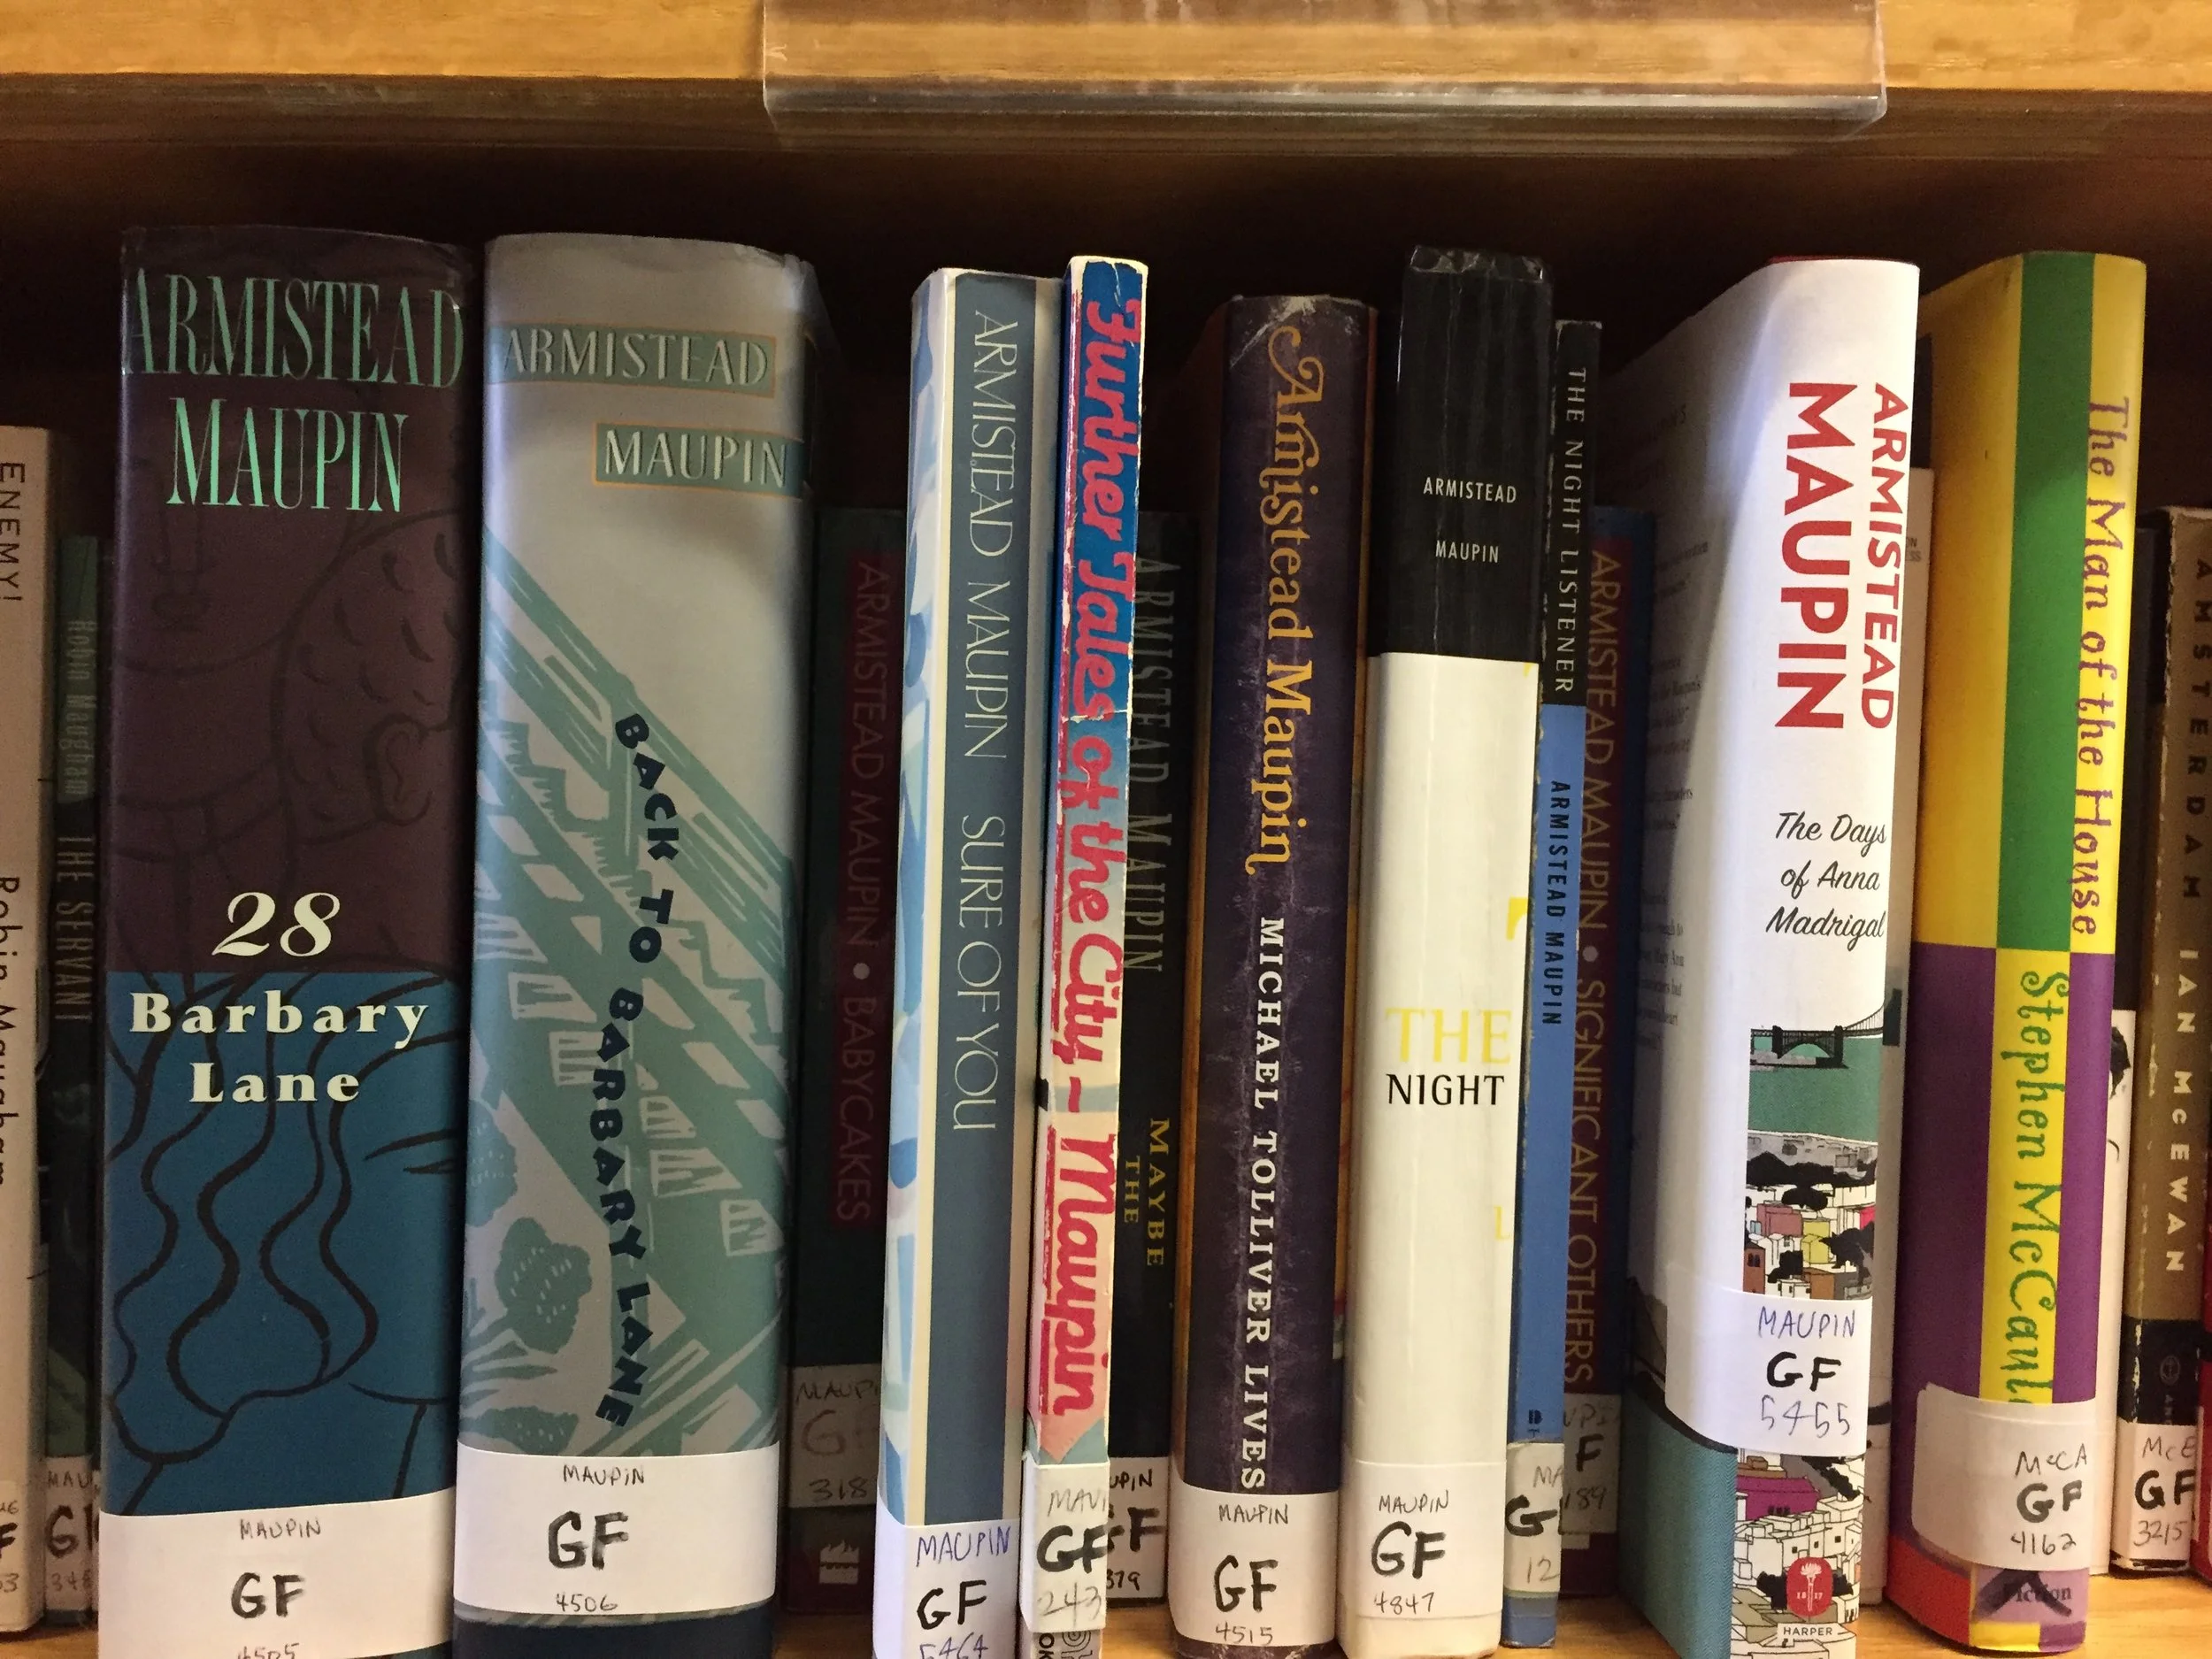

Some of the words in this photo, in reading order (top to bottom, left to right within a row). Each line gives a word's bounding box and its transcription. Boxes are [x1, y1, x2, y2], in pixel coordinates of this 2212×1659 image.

[123, 268, 465, 388] ARMISTEAD
[503, 327, 769, 386] ARMISTEAD
[969, 310, 1019, 557] ARMISTEAD
[1082, 297, 1142, 542] Further
[1565, 367, 1587, 424] THE
[165, 397, 409, 512] MAUPIN
[604, 429, 788, 488] MAUPIN
[2088, 396, 2130, 477] The
[1258, 325, 1325, 641] Armistead
[1423, 476, 1517, 503] ARMISTEAD
[1561, 440, 1585, 534] NIGHT
[1435, 540, 1500, 564] MAUPIN
[1775, 382, 1858, 729] MAUPIN
[1861, 382, 1909, 729] ARMISTEAD
[2082, 497, 2125, 611] Man
[1071, 549, 1135, 723] Tales
[1555, 549, 1580, 693] LISTENER
[1585, 549, 1622, 766] ARMISTEAD
[2078, 630, 2118, 680] of
[849, 560, 891, 780] ARMISTEAD
[964, 580, 1011, 758] MAUPIN
[1129, 555, 1181, 782] ARMISTEAD
[2076, 692, 2116, 766] the
[2183, 557, 2212, 899] AMSTERDAM
[615, 713, 679, 861] BACK
[1062, 735, 1121, 810] of
[1245, 659, 1313, 876] Maupin
[57, 835, 96, 883] THE
[845, 788, 880, 948] MAUPIN
[958, 815, 1006, 929] SURE
[1069, 820, 1128, 926] the
[1547, 780, 1571, 918] ARMISTEAD
[1579, 780, 1612, 930] MAUPIN
[1775, 810, 1823, 841] The
[1830, 813, 1887, 858] Days
[2067, 789, 2114, 935] House
[1124, 812, 1173, 972] MAUPIN
[1780, 859, 1810, 900] of
[1816, 860, 1881, 891] Anna
[55, 902, 95, 1024] SERVANT
[211, 892, 341, 956] 28
[629, 888, 674, 964] TO
[1765, 906, 1887, 952] Madrigal
[956, 940, 1002, 1013] OF
[1051, 933, 1125, 1064] City
[1253, 917, 1286, 1110] MICHAEL
[1542, 931, 1565, 1026] MAUPIN
[2177, 949, 2200, 1034] IAN
[129, 989, 429, 1049] Barbary
[1385, 1007, 1512, 1064] THE
[188, 1062, 360, 1102] Lane
[953, 1022, 1000, 1130] YOU
[1386, 1073, 1505, 1105] NIGHT
[1570, 979, 1606, 1224] SIGNIFICANT
[2001, 970, 2070, 1161] Stephen
[590, 987, 647, 1260] BARBARY
[835, 995, 878, 1222] BABYCAKES
[1123, 1155, 1141, 1225] THE
[1147, 1118, 1171, 1267] MAYBE
[1044, 1133, 1118, 1417] Maupin
[1245, 1130, 1279, 1344] TOLLIVER
[1563, 1233, 1600, 1385] OTHERS
[1757, 1305, 1855, 1339] MAUPIN
[595, 1282, 654, 1427] LANE
[1766, 1351, 1842, 1393] GF
[1240, 1364, 1270, 1490] LIVES
[1761, 1394, 1851, 1439] 5455
[563, 1463, 646, 1486] MAUPIN
[1378, 1489, 1450, 1514] MAUPIN
[2016, 1480, 2083, 1524] GF
[2135, 1470, 2196, 1511] GF
[240, 1517, 322, 1540] MAUPIN
[548, 1510, 629, 1571] GF
[916, 1525, 1011, 1567] MAUPIN
[1036, 1524, 1109, 1574] GF
[1218, 1503, 1289, 1525] MAUPIN
[1371, 1520, 1447, 1580] GF
[2010, 1531, 2077, 1555] 4162
[2133, 1519, 2189, 1548] 3215
[231, 1571, 306, 1619] GF
[555, 1593, 618, 1613] 4506
[916, 1579, 987, 1630] GF
[1213, 1554, 1279, 1614] GF
[1373, 1592, 1435, 1616] 4847
[1214, 1620, 1274, 1646] 4515
[1783, 1626, 1833, 1636] HARPER
